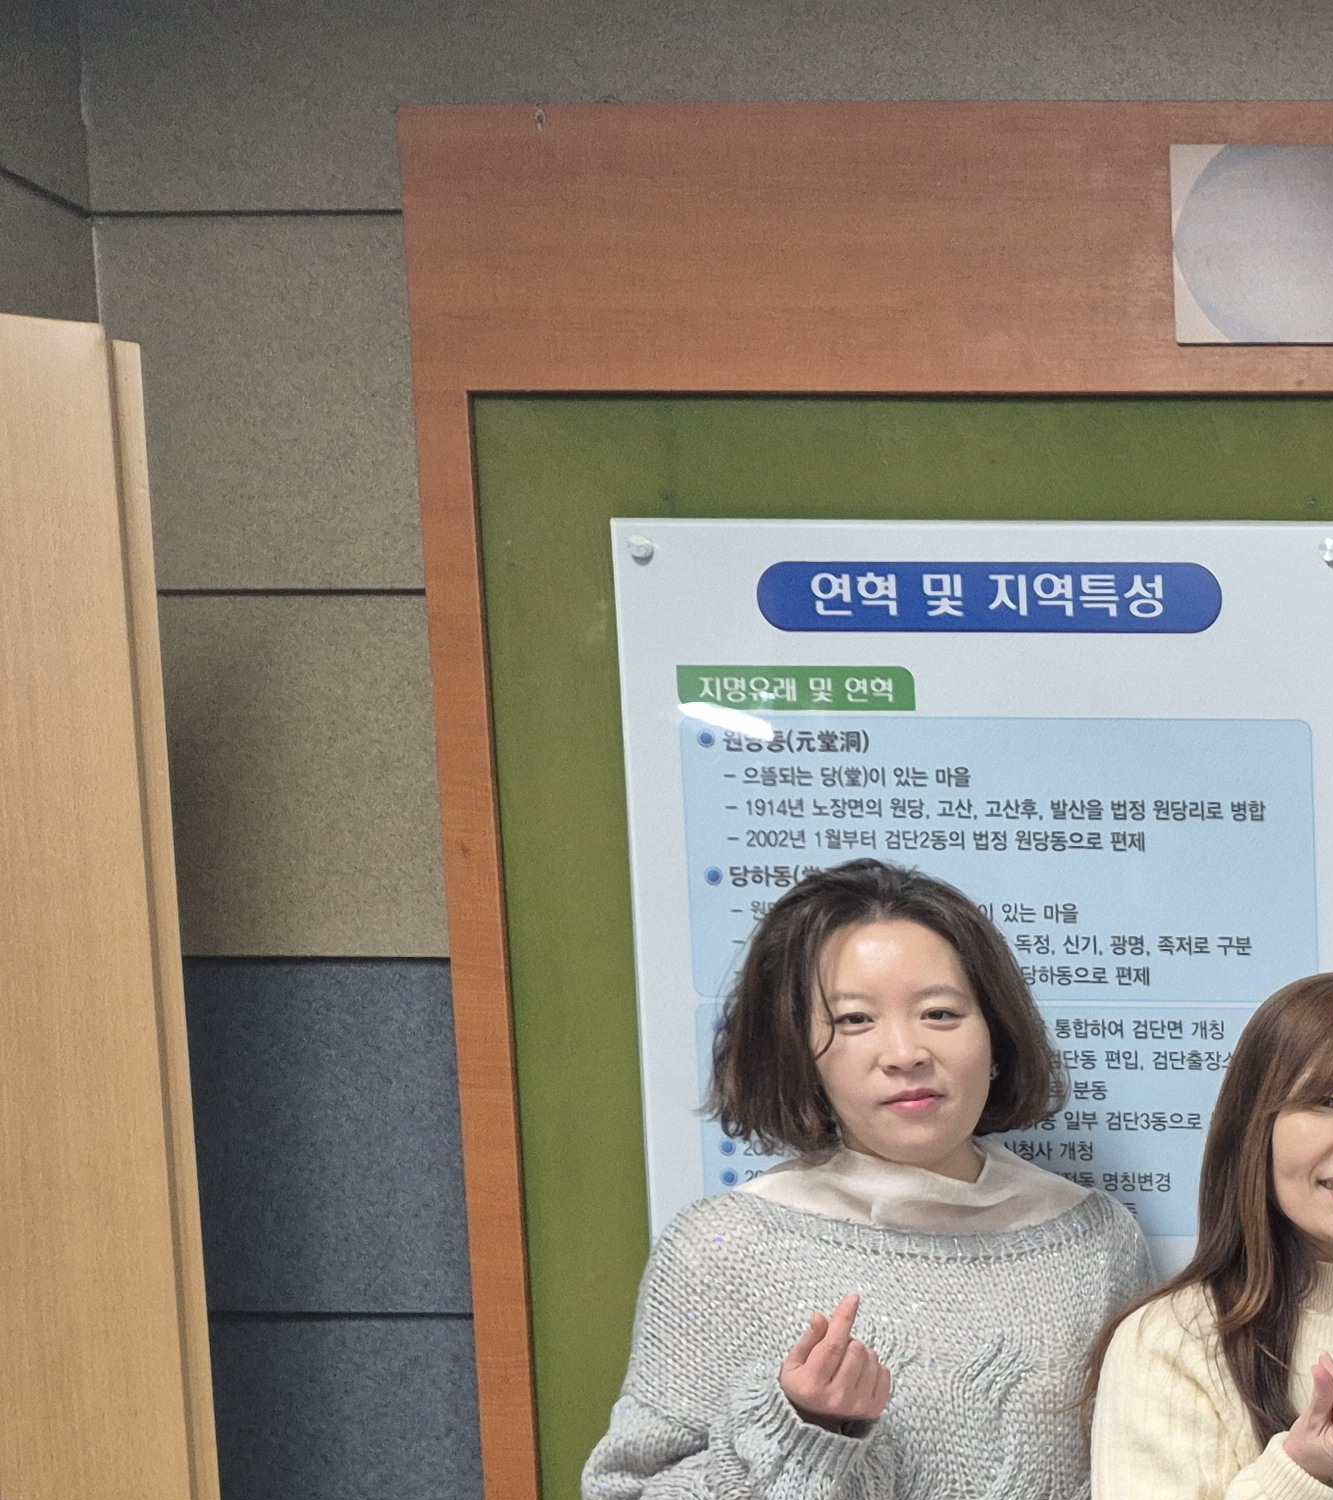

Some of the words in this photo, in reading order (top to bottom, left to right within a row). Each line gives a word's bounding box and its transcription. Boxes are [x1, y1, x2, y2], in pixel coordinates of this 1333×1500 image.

[810, 572, 899, 617] 연혁
[923, 573, 963, 617] 및
[988, 573, 1165, 619] 지역특성
[699, 677, 797, 702] 지명유래
[809, 677, 833, 702] 및
[845, 678, 894, 702] 연혁
[743, 768, 812, 787] 으뜸되는
[821, 766, 886, 788] 당(堂)이
[894, 767, 929, 787] 있는
[936, 767, 970, 788] 마을
[746, 800, 804, 818] 1914년
[813, 799, 882, 819] 노장면의
[890, 799, 930, 820] 원당,
[937, 800, 977, 820] 고산,
[985, 799, 1044, 821] 고산후,
[1051, 799, 1103, 821] 발산을
[1111, 800, 1146, 821] 법정
[1153, 800, 1224, 821] 원당리로
[1231, 800, 1266, 822] 병합
[746, 829, 806, 849] 2002년
[814, 829, 876, 849] 1월부터
[885, 830, 966, 850] 검단2동의
[973, 831, 1008, 851] 법정
[1014, 831, 1103, 852] 원당동으로
[1110, 831, 1145, 852] 편제
[1001, 903, 1036, 923] 있는
[1043, 903, 1079, 924] 마을
[1014, 934, 1055, 956] 독정,
[1062, 934, 1103, 956] 신기,
[1110, 934, 1151, 957] 광명,
[1158, 935, 1210, 955] 족저로
[1216, 936, 1252, 956] 구분
[1115, 966, 1151, 987] 편제
[1054, 1019, 1124, 1039] 통합하여
[1132, 1019, 1184, 1040] 검단면
[1191, 1020, 1225, 1040] 개칭
[1104, 1050, 1145, 1071] 편입,
[1073, 1081, 1108, 1100] 분동
[1064, 1112, 1099, 1131] 일부
[1106, 1112, 1203, 1131] 검단3동으로
[1059, 1141, 1094, 1161] 개청
[1102, 1171, 1171, 1192] 명칭변경
